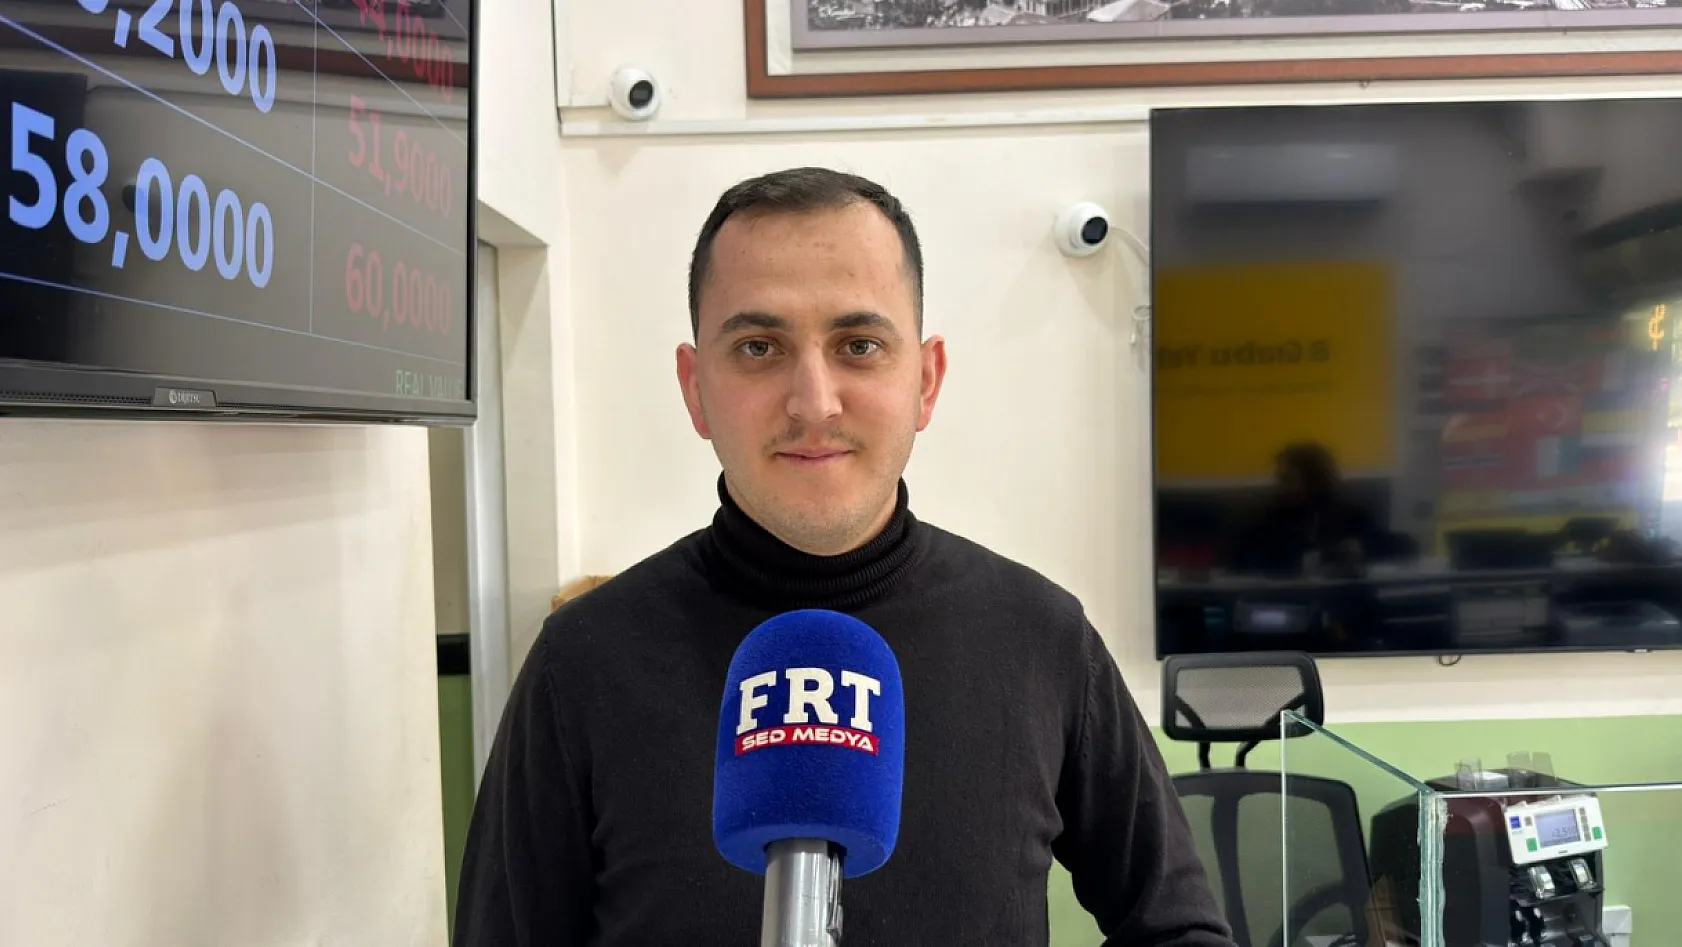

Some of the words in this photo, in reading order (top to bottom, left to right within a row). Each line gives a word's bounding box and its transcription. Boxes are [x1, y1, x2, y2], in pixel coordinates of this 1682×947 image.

[77, 0, 277, 113] ,2000
[9, 101, 274, 288] 58,0000
[348, 94, 452, 219] 51,9000
[345, 243, 452, 336] 60,0000
[736, 667, 881, 735] FRT
[742, 729, 786, 751] SED
[792, 727, 874, 752] MEDYA
